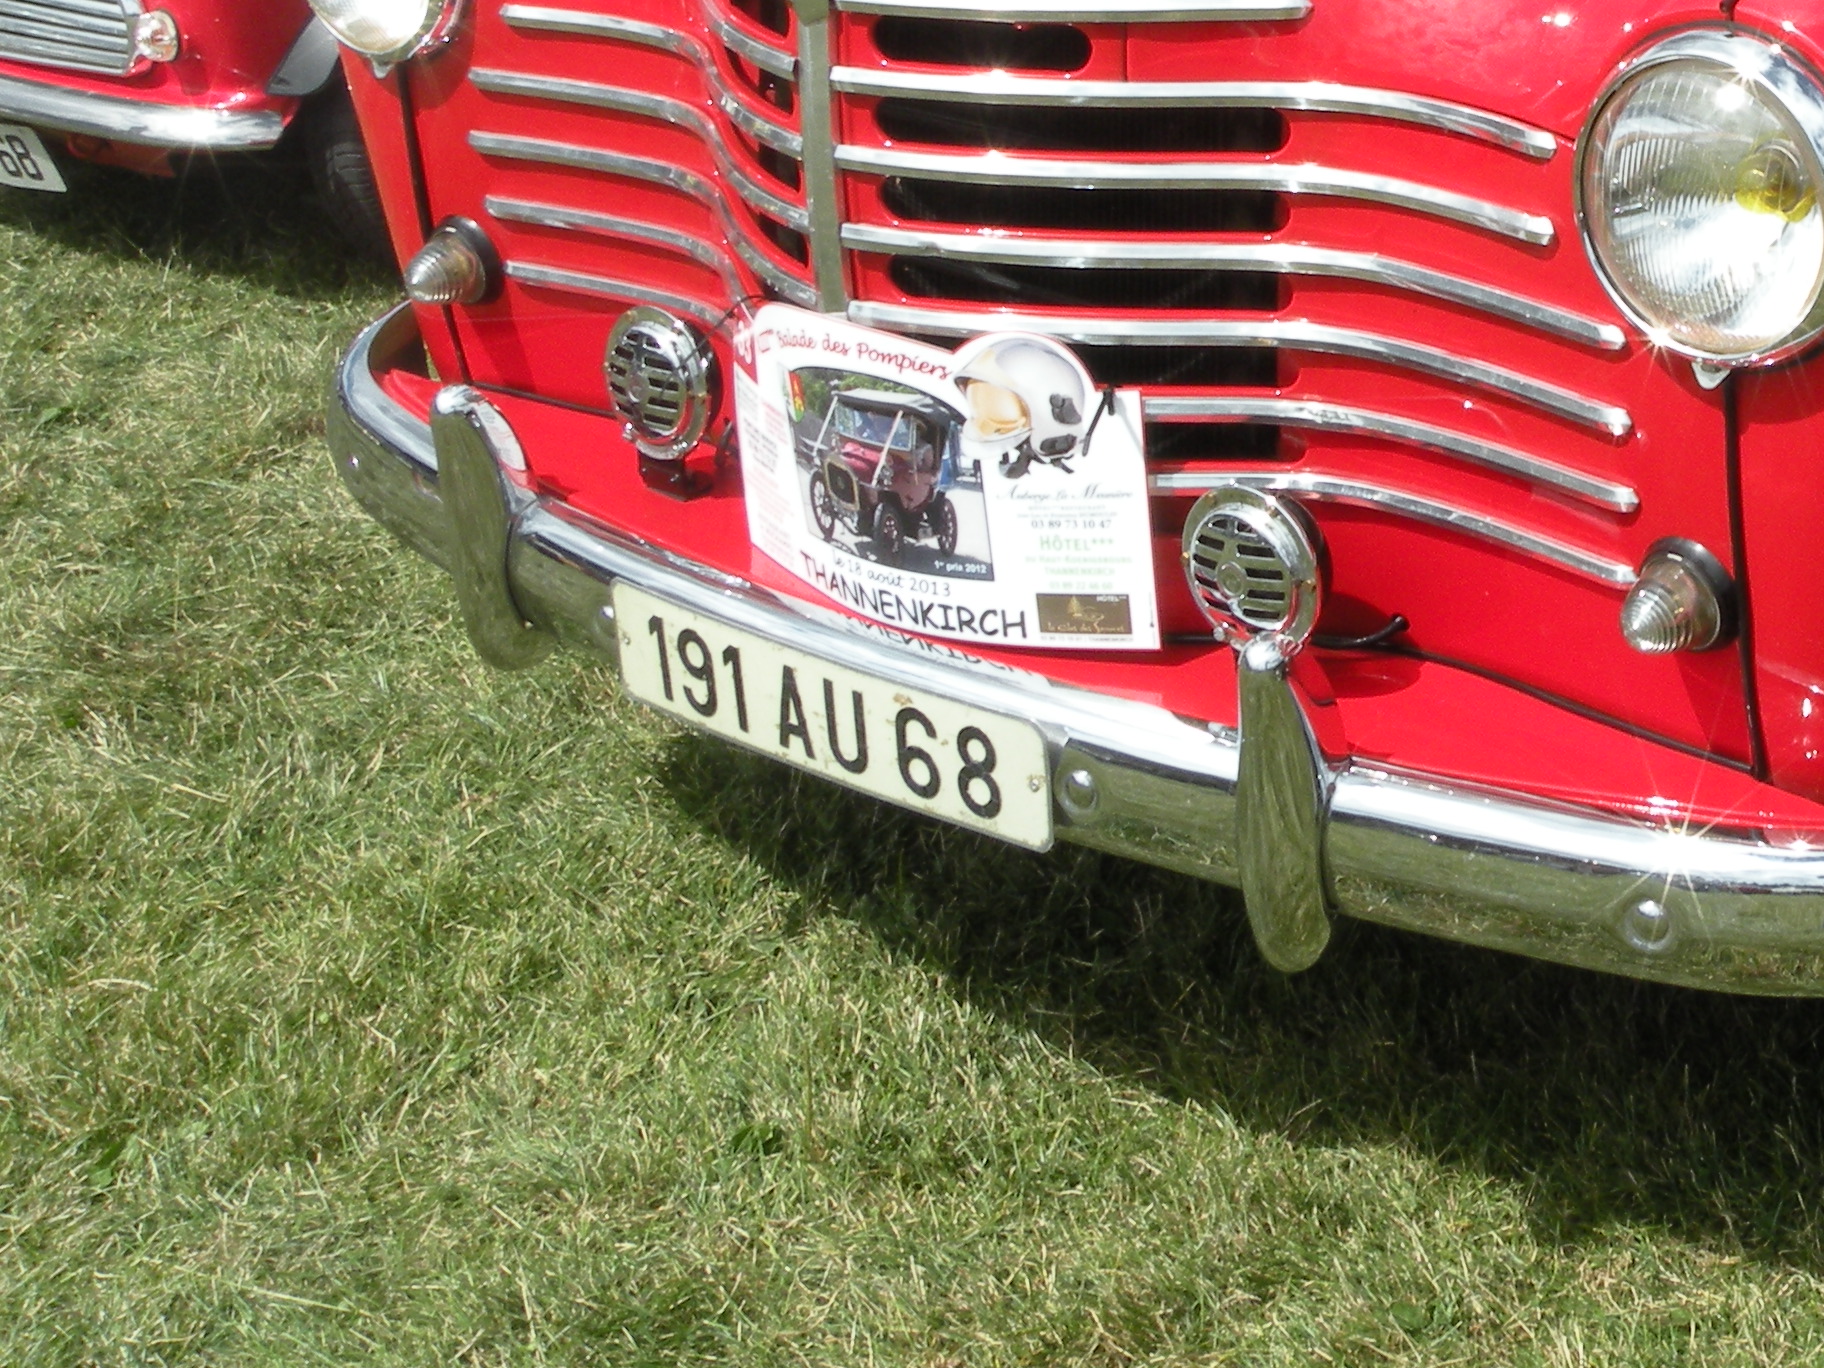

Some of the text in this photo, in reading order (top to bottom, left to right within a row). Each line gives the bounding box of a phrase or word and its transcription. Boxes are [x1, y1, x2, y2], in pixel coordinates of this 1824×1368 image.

[822, 332, 851, 357] des
[856, 340, 954, 381] Pompiers
[1031, 519, 1112, 530] 03 89 73 10 47
[847, 559, 862, 576] 18
[866, 569, 905, 589] août
[910, 577, 952, 598] 2013
[964, 562, 988, 575] 2012
[799, 549, 1028, 639] THANNENKIRCH
[648, 615, 749, 733] 191
[779, 665, 869, 775] AU
[894, 706, 1003, 820] 68
